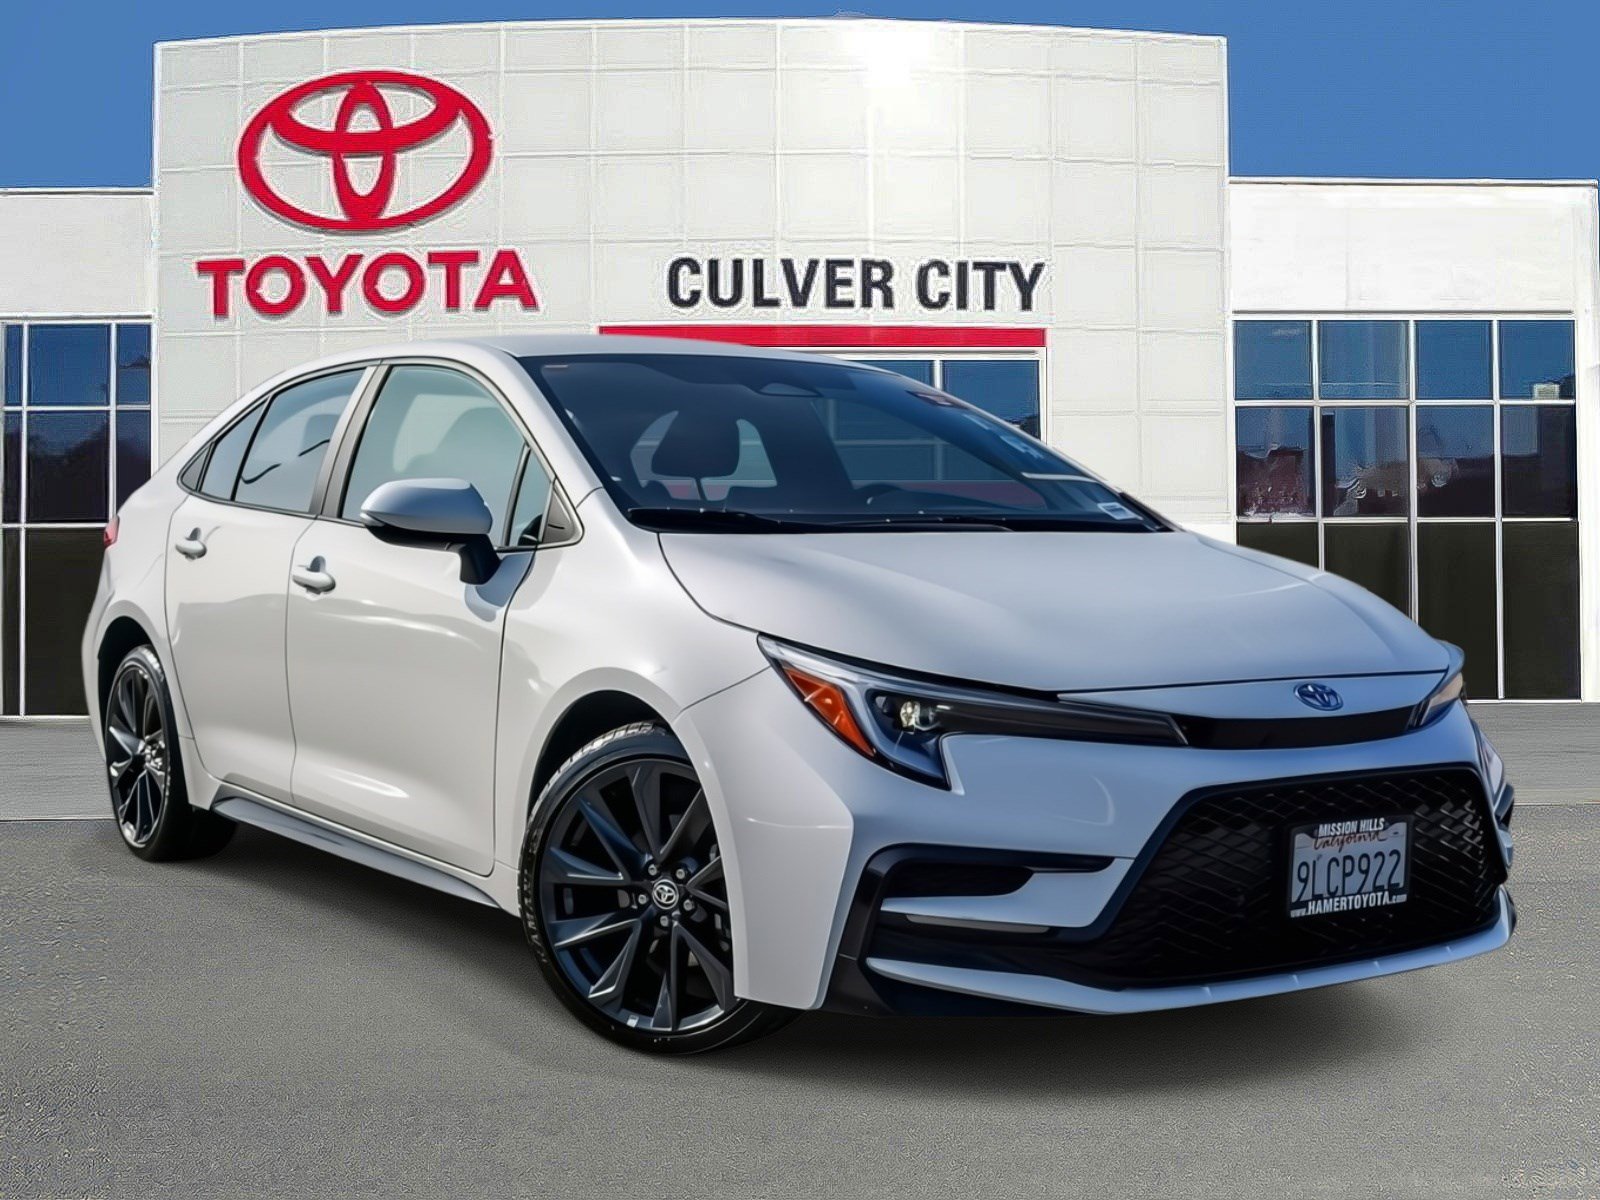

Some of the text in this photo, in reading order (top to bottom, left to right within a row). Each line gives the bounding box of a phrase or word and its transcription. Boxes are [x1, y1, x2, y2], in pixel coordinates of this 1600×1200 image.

[196, 249, 539, 317] TOYOTA
[667, 257, 1046, 311] CULVER CITY
[1318, 817, 1385, 837] MISSION HILLS
[1296, 849, 1401, 901] 9LCP922
[1290, 891, 1407, 918] www.HAMERTOYOTA.com
